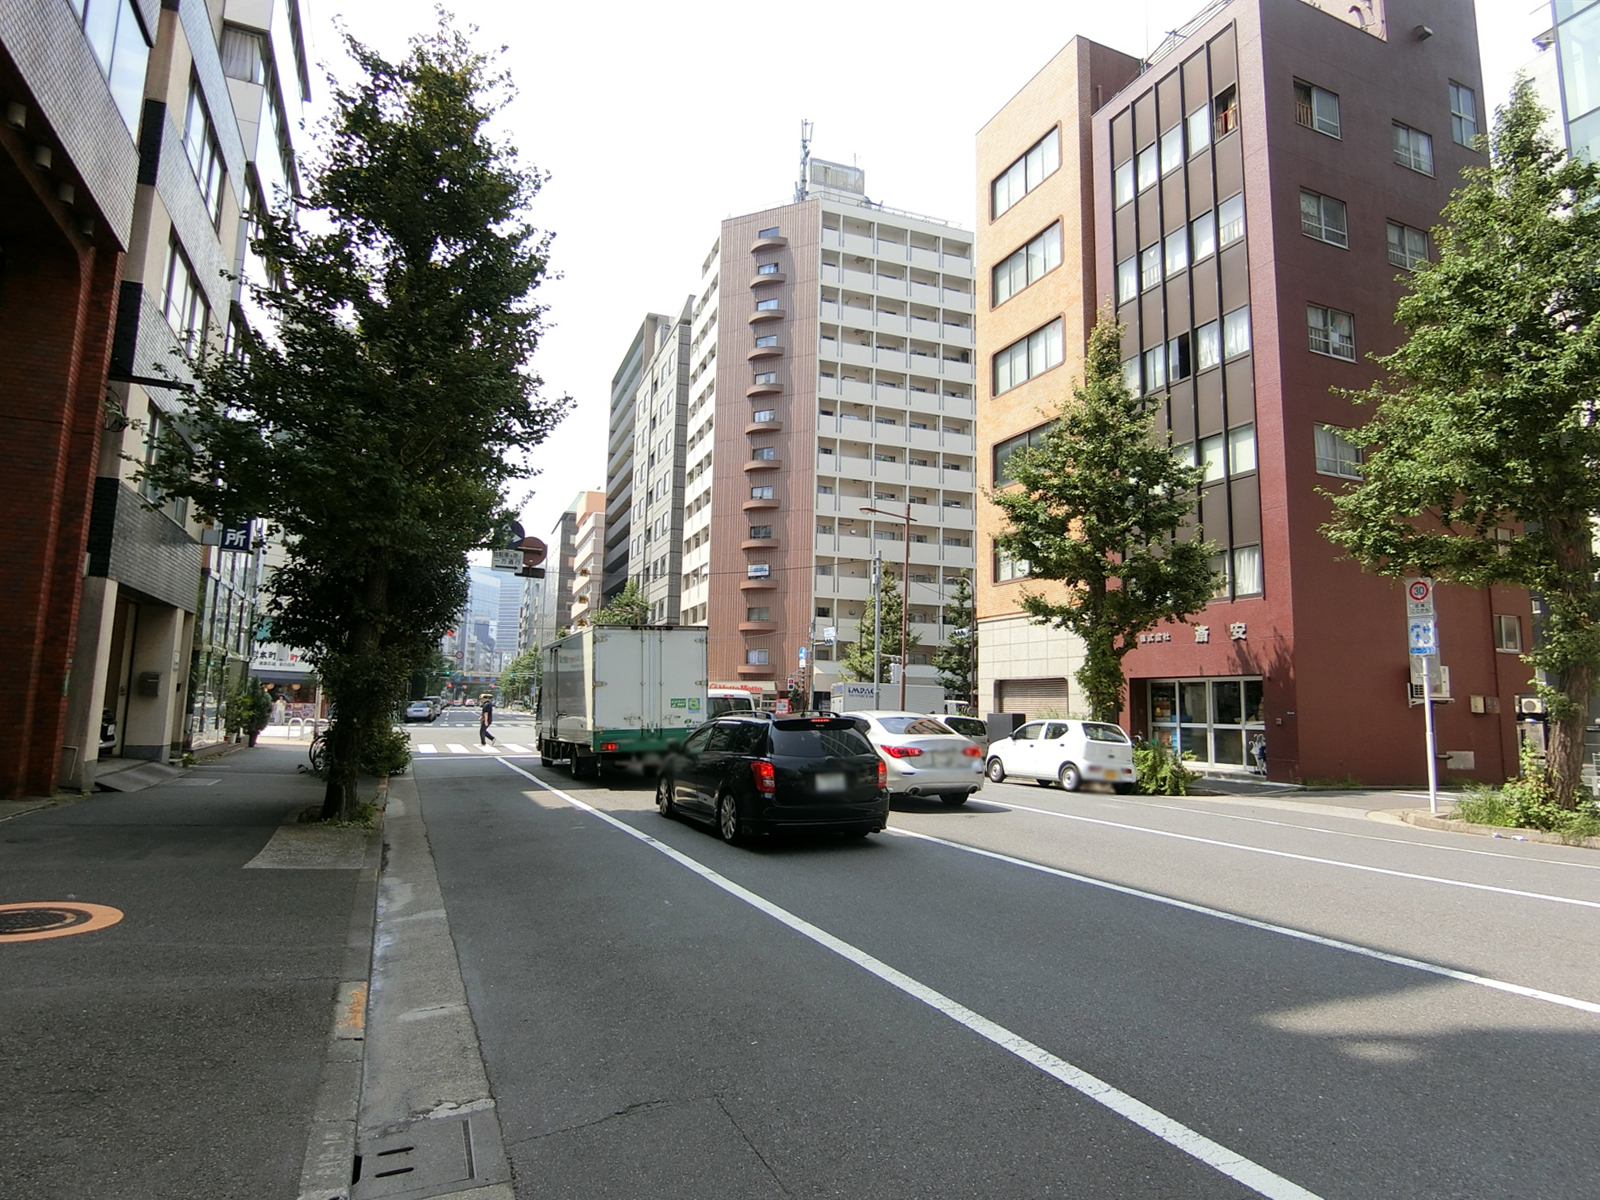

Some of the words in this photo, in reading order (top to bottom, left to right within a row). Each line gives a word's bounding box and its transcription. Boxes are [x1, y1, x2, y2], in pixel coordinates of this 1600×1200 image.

[224, 528, 247, 547] 所
[1413, 586, 1425, 596] 30
[1140, 632, 1171, 643] 株式会社
